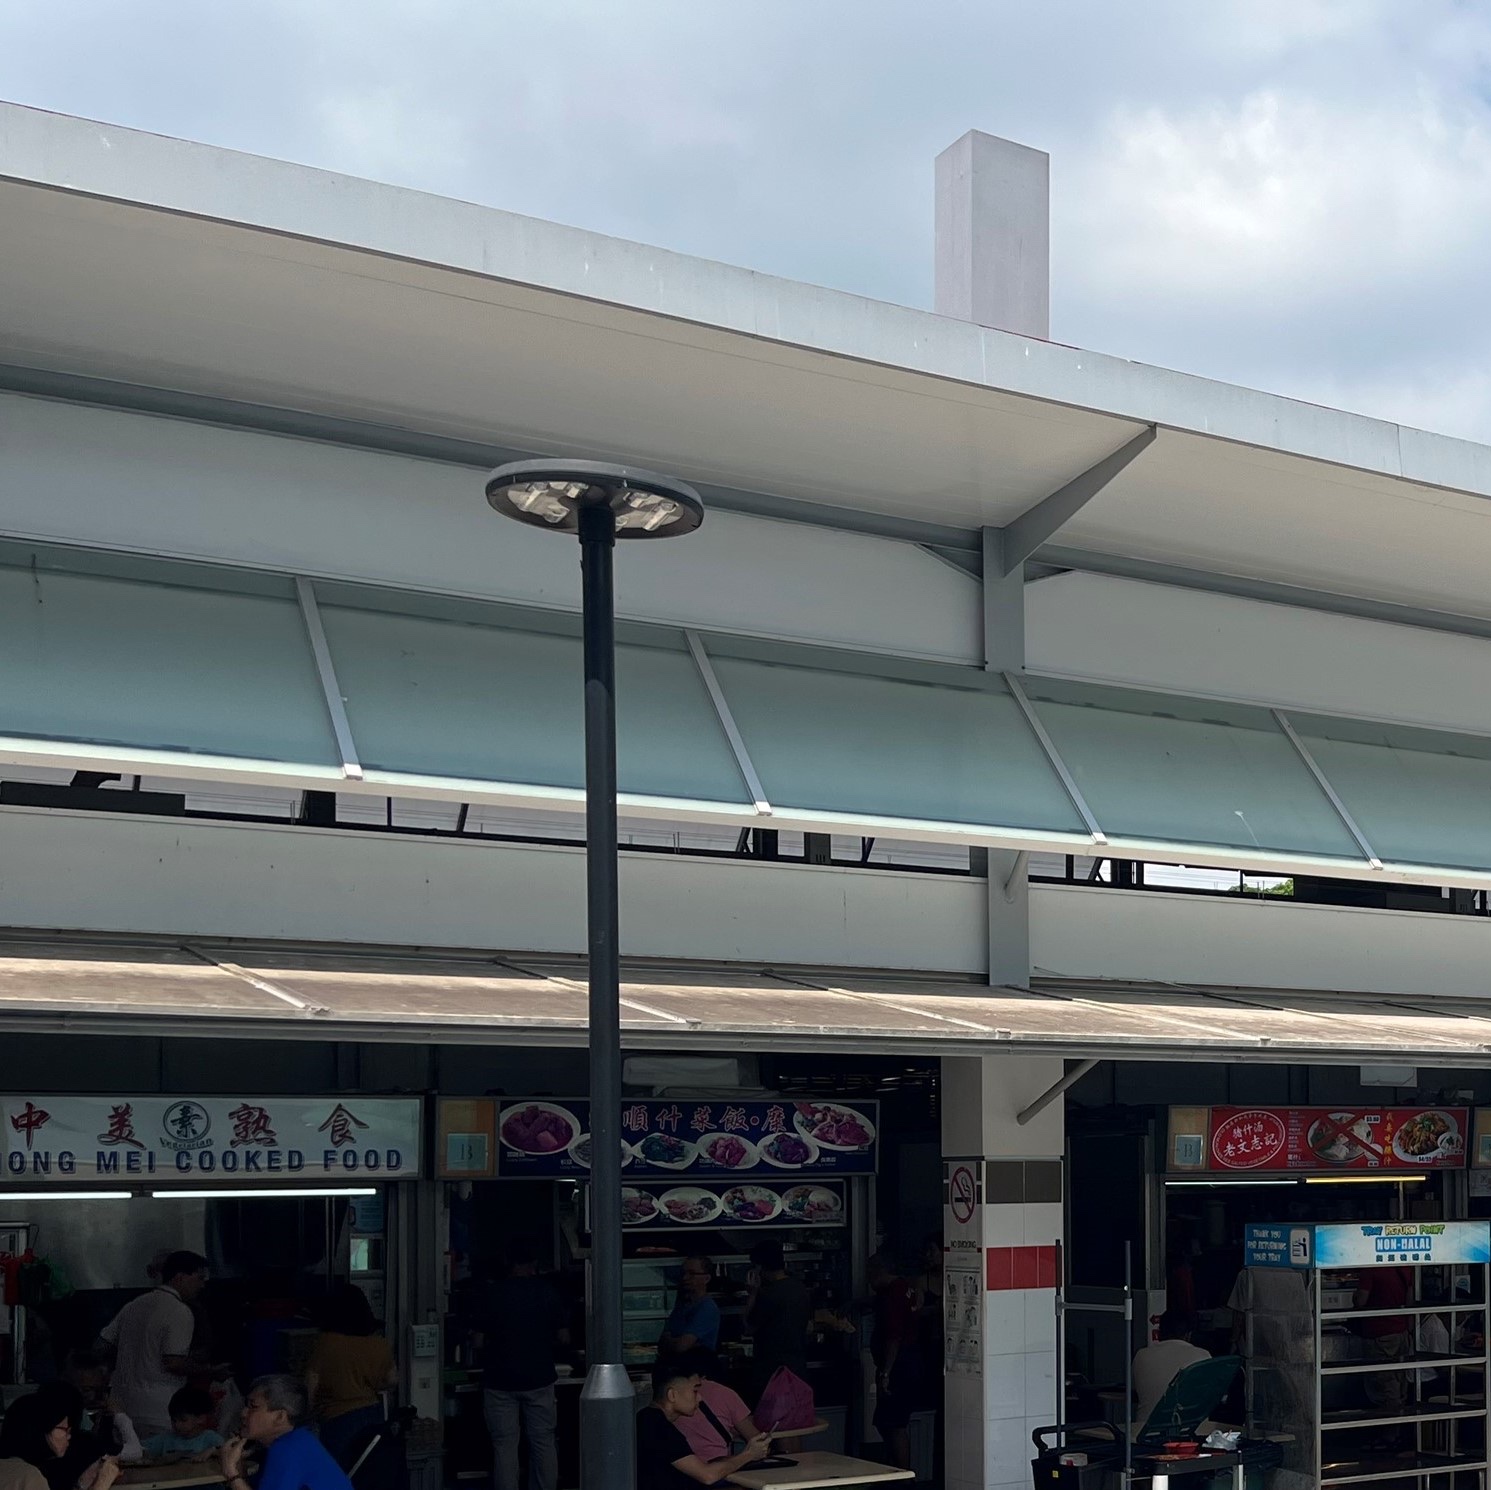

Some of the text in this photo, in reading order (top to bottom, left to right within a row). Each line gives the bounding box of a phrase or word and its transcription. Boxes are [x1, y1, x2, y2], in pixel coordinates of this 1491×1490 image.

[170, 1105, 204, 1138] 素
[159, 1137, 215, 1151] Vegetarian
[0, 1149, 402, 1174] ONG MEI COOKED FOOD
[1253, 1229, 1281, 1239] THANK YOU
[1361, 1224, 1445, 1236] TRAY RETURN POINT
[1258, 1241, 1287, 1250] RETURNING
[1376, 1237, 1431, 1251] NON-HALAL
[1253, 1252, 1281, 1262] YOUR TRAY
